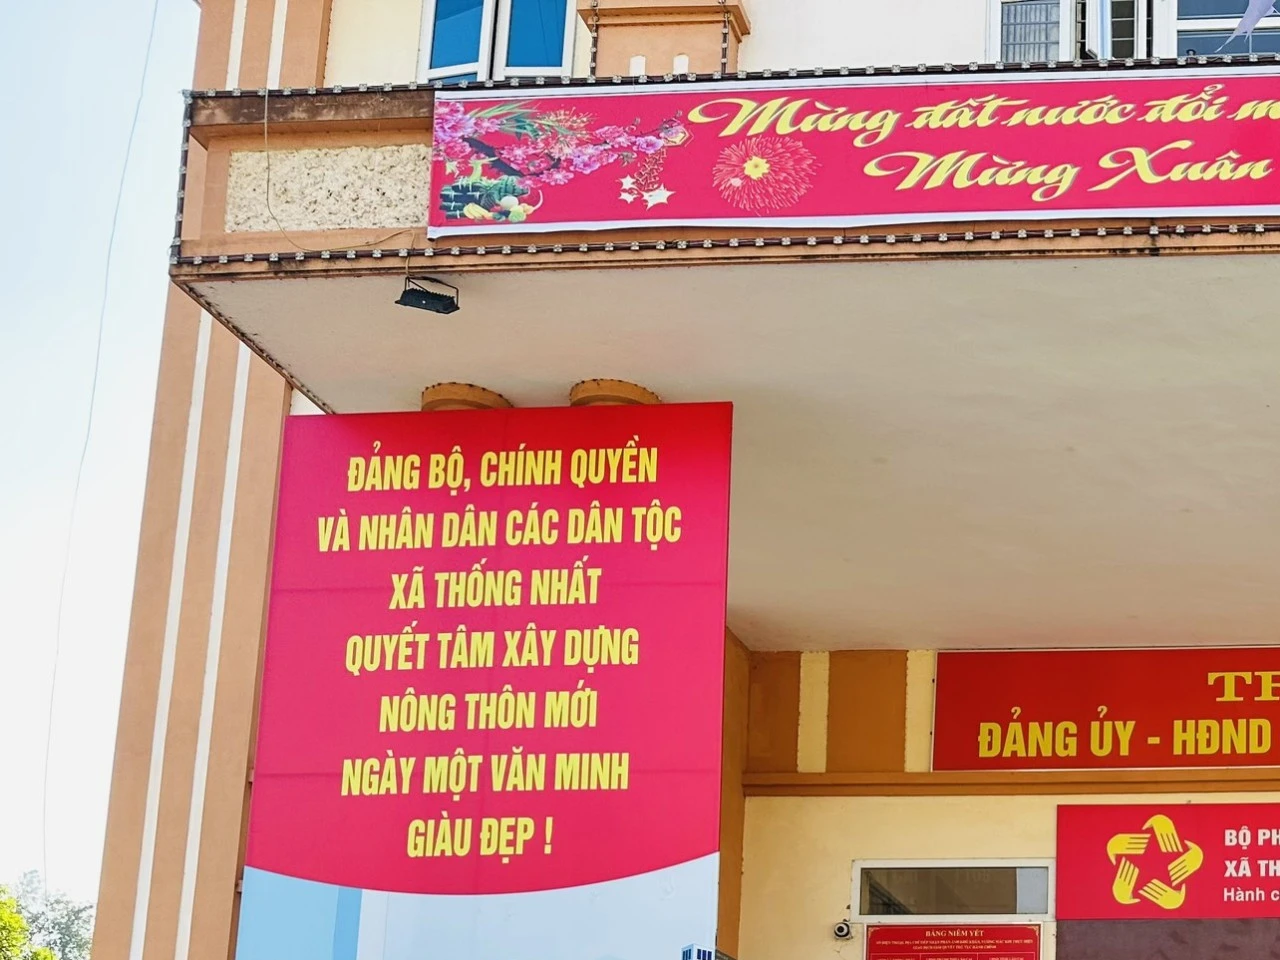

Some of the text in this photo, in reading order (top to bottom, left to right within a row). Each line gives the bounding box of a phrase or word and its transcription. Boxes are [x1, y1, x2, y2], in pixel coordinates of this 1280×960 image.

[688, 95, 901, 148] Mừng
[905, 93, 1010, 130] đất
[1001, 92, 1137, 128] nước
[1136, 83, 1226, 123] đổi
[862, 147, 1080, 202] Mừng
[1088, 139, 1274, 193] Xuân
[347, 434, 657, 496] ĐẢNG BỘ, CHÍNH QUYỀN
[318, 498, 682, 552] VÀ NHÂN DÂN CÁC DÂN TỘC
[389, 555, 602, 610] XÃ THỐNG NHẤT
[345, 620, 639, 676] QUYẾT TÂM XÂY DỰNG
[379, 679, 597, 732] NÔNG THÔN MỚI
[978, 707, 1078, 758] ĐẢNG
[1090, 706, 1136, 757] ỦY
[1173, 718, 1272, 755] HĐND
[341, 745, 629, 802] NGÀY MỘT VĂN MINH
[407, 811, 554, 864] GIÀU ĐẸP !
[1224, 825, 1251, 850] BỘ
[1224, 857, 1252, 877] XÃ
[1223, 887, 1265, 902] Hành
